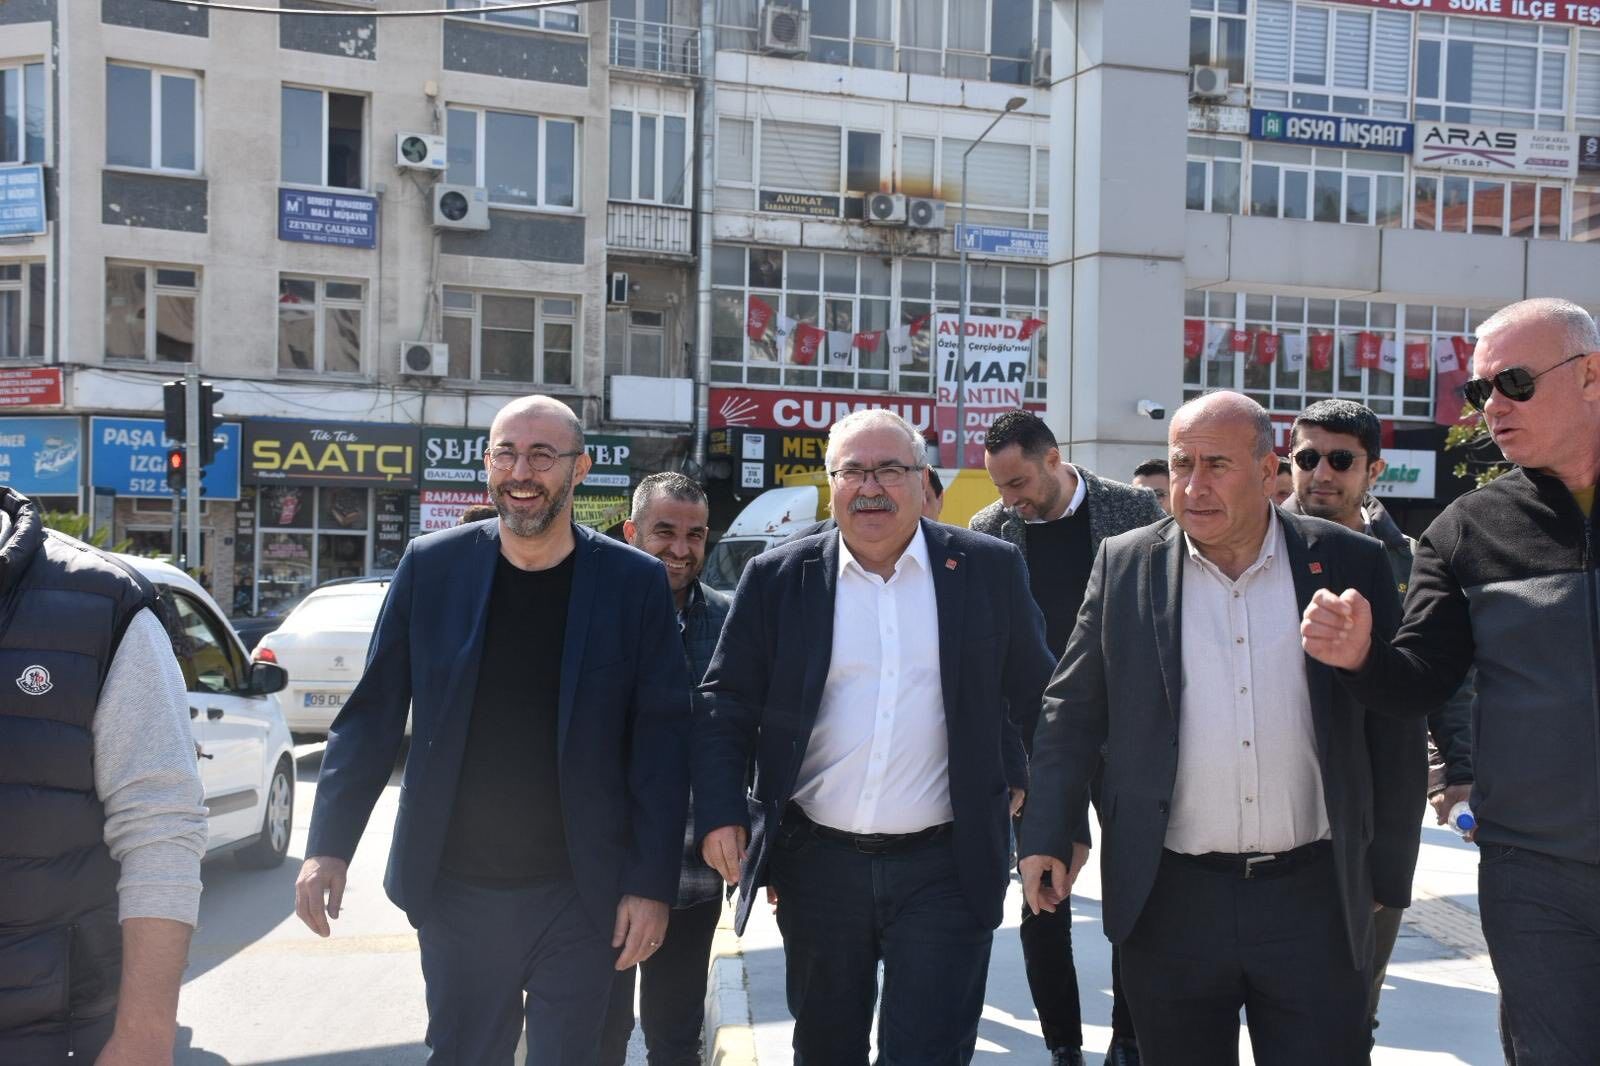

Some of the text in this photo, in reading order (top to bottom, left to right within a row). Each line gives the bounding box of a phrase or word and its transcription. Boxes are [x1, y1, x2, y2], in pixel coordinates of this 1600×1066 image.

[1286, 117, 1407, 148] ASYA İNŞAAT
[1424, 126, 1517, 149] ARAS
[776, 194, 823, 206] AVUKAT
[310, 207, 330, 218] MALİ
[288, 220, 322, 231] ZEYNEP
[944, 351, 1027, 383] İMAR
[938, 386, 1021, 405] RANTIN
[103, 428, 156, 450] PAŞA
[310, 429, 358, 442] Tik Tak
[425, 436, 489, 467] ŞEH
[252, 440, 413, 481] SAATÇI
[427, 471, 473, 479] BAKLAVA
[129, 478, 156, 492] 512
[425, 491, 483, 503] RAMAZAN
[312, 695, 344, 705] 09 DL
